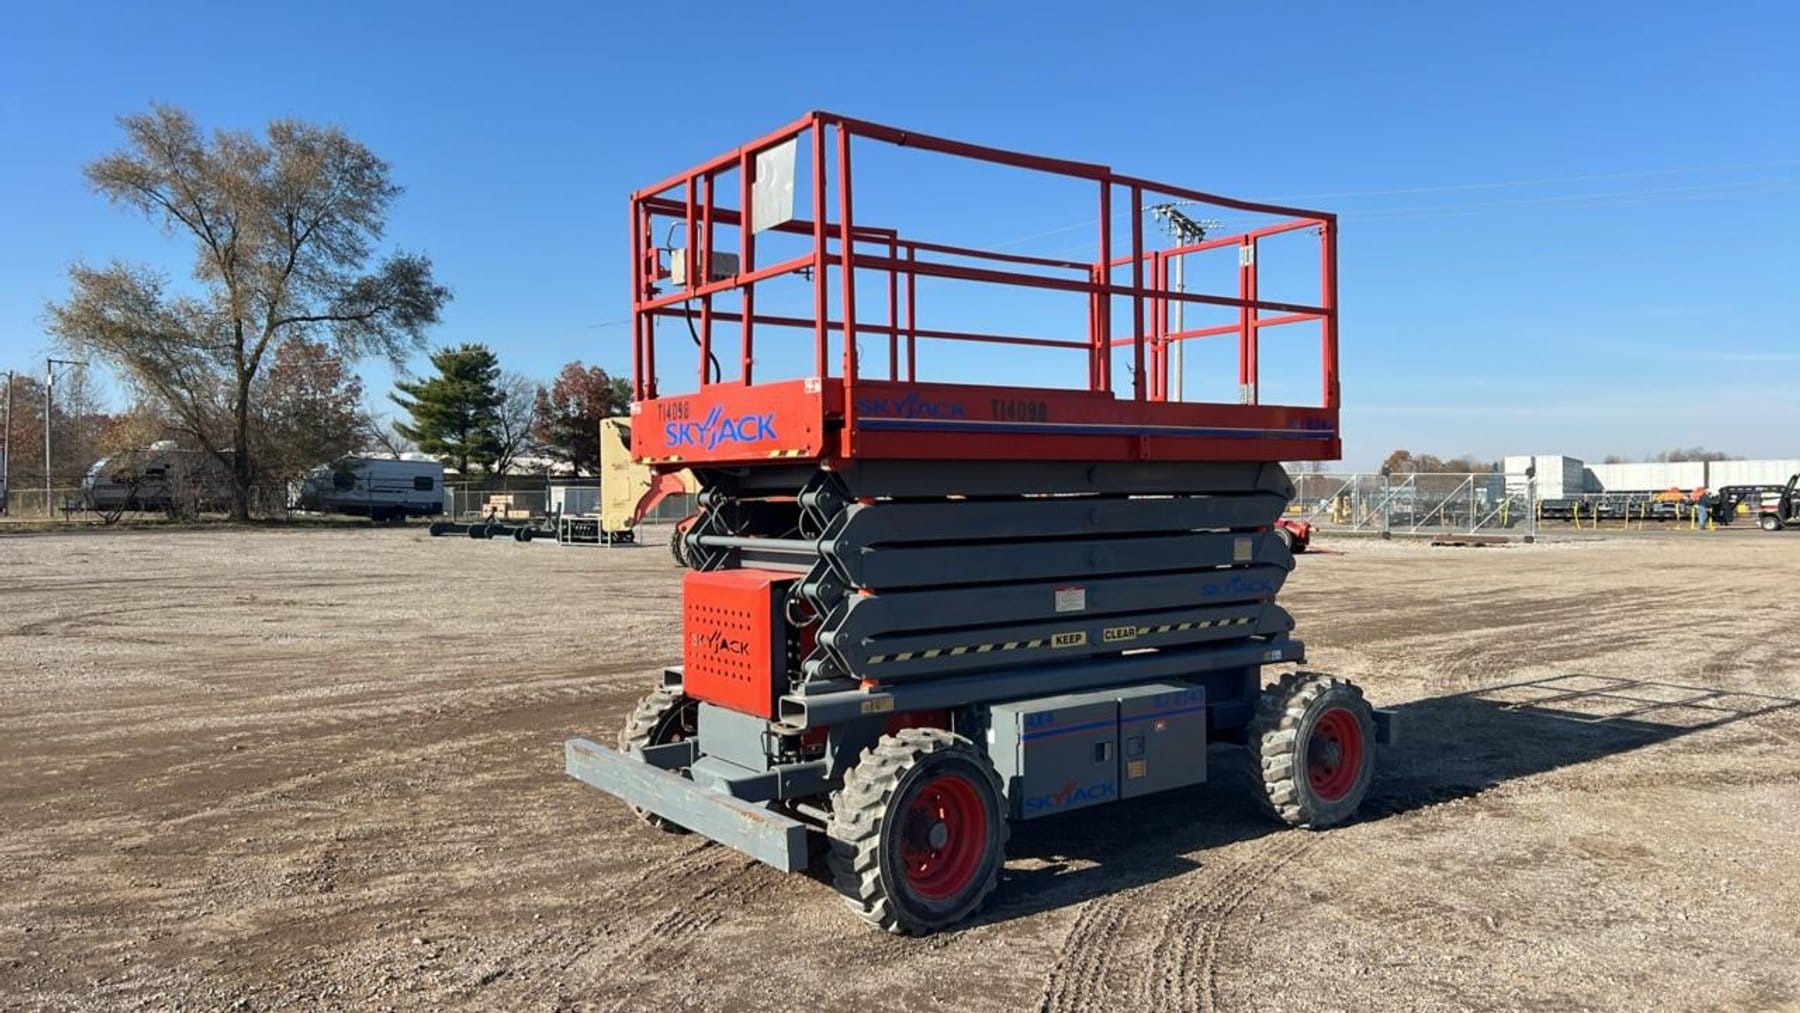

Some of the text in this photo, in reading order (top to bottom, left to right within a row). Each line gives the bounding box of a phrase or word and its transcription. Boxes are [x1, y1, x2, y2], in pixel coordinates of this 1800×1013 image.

[665, 405, 776, 450] SKYJACK
[1055, 628, 1136, 645] KEEP CLEAR
[1024, 780, 1116, 812] SKYJACK
